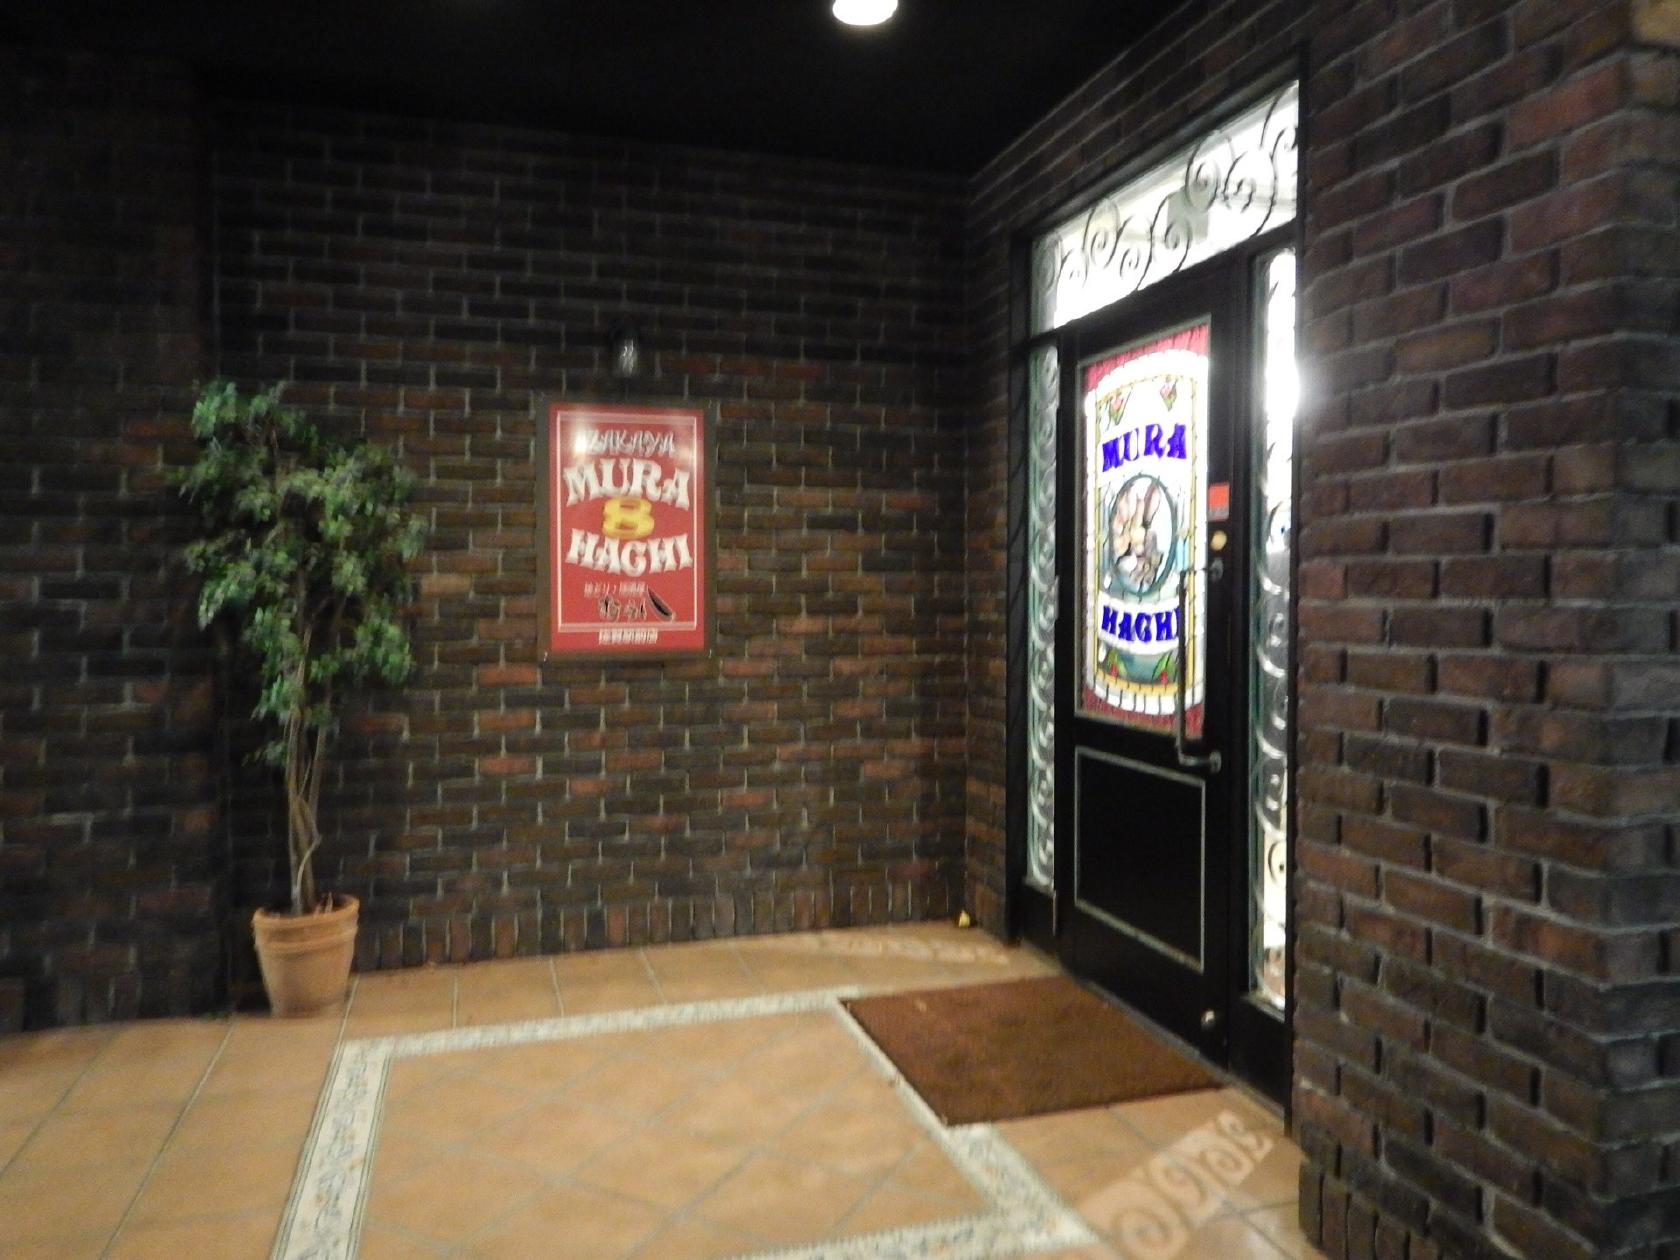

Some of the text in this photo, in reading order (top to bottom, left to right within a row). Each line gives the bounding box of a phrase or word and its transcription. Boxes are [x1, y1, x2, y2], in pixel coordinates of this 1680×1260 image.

[576, 429, 675, 458] ZAKAYA
[1102, 422, 1187, 473] MURA
[563, 458, 690, 511] MURA
